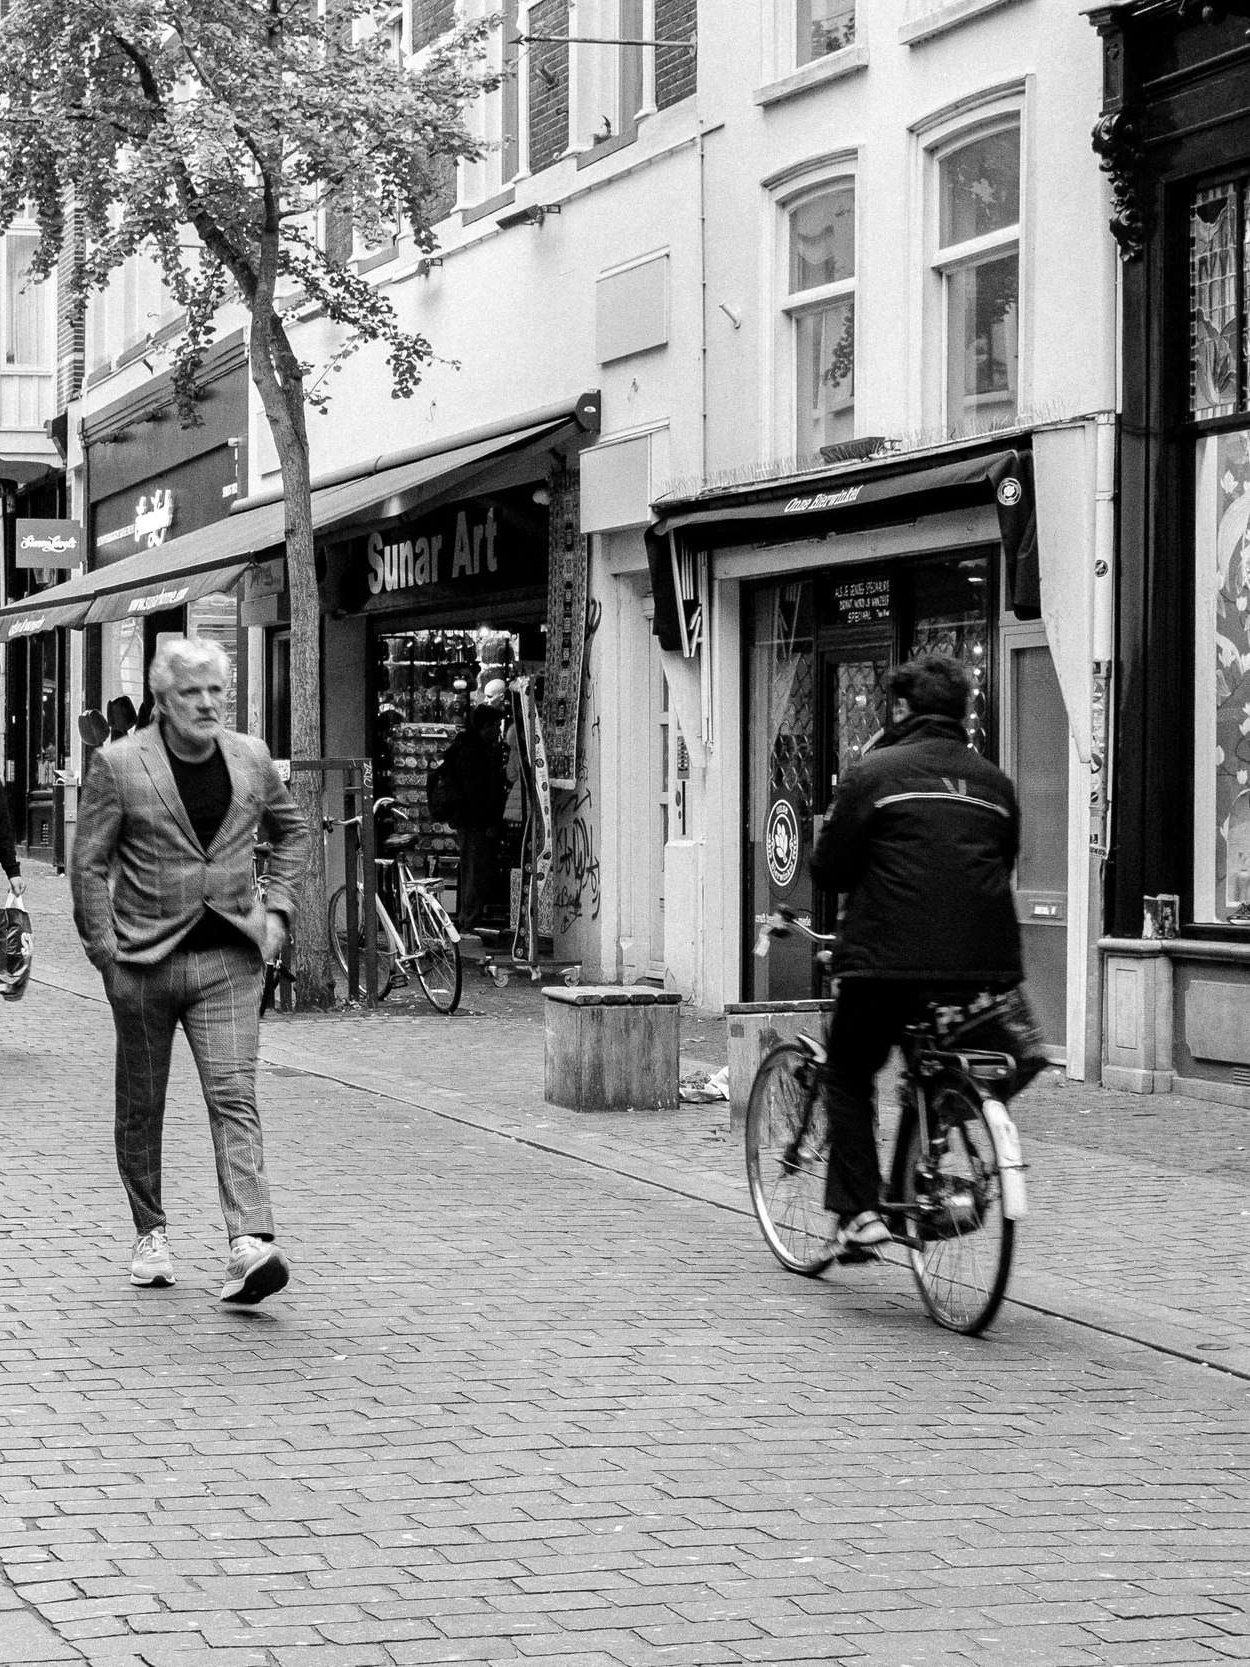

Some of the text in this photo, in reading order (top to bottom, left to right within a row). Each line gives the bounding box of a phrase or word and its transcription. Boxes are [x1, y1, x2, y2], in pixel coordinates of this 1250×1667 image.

[784, 484, 864, 513] Onze Bierwinkel
[367, 507, 498, 594] Sunar Art
